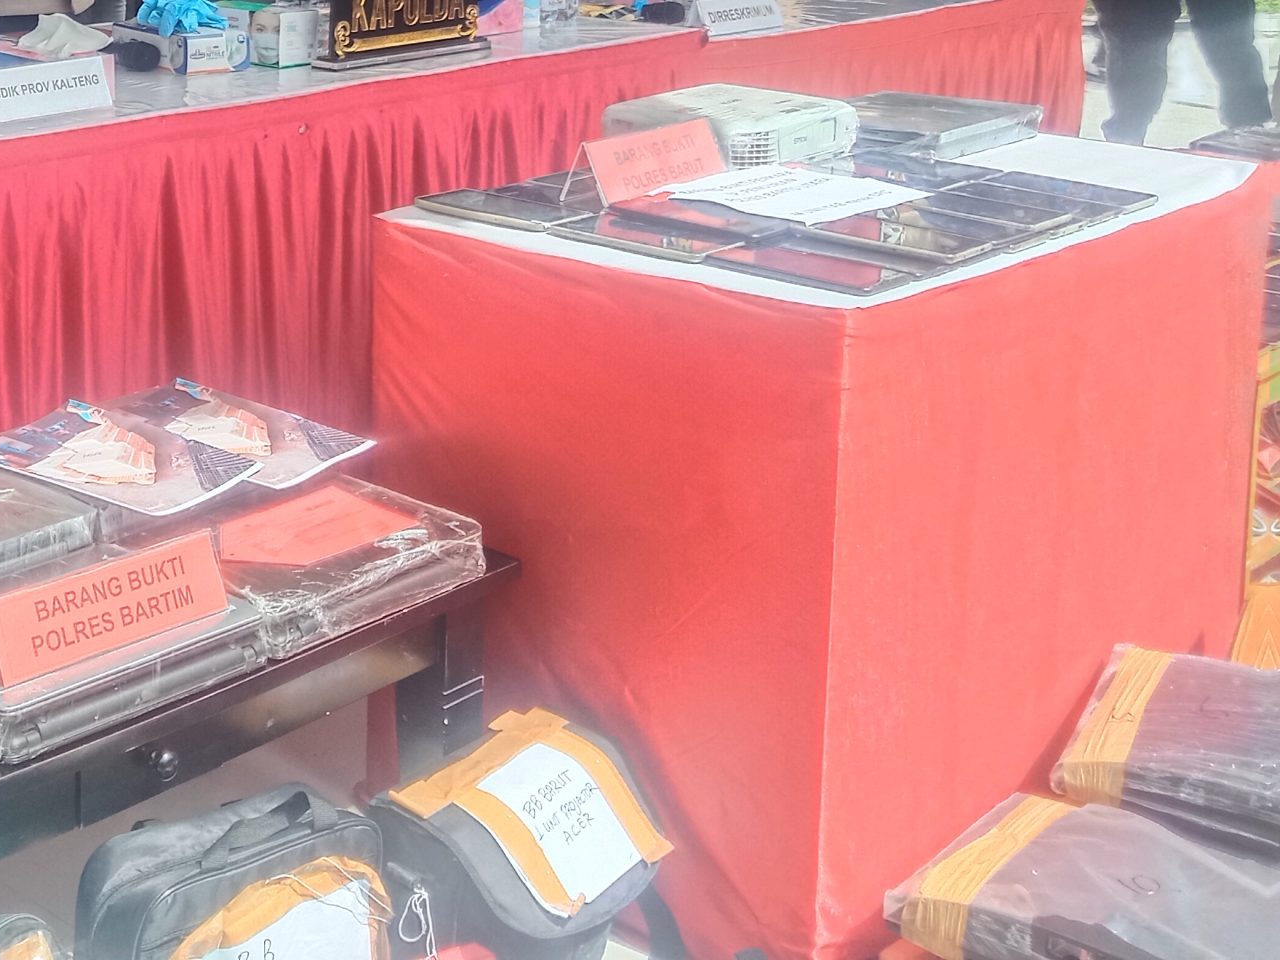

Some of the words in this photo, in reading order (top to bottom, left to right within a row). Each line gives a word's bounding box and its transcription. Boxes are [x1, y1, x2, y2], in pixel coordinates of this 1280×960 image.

[707, 4, 774, 24] DIRRESKRIMUM
[21, 80, 49, 97] PROV
[52, 73, 100, 92] KALTENG
[613, 141, 662, 166] BARANG
[662, 134, 696, 154] BUKTI
[622, 169, 667, 192] POLRES
[668, 157, 705, 180] BARUT
[33, 576, 124, 623] BARANG
[127, 555, 187, 591] BUKTI
[31, 611, 116, 658] POLRES
[119, 585, 195, 628] BARTIM
[562, 812, 595, 846] ACER
